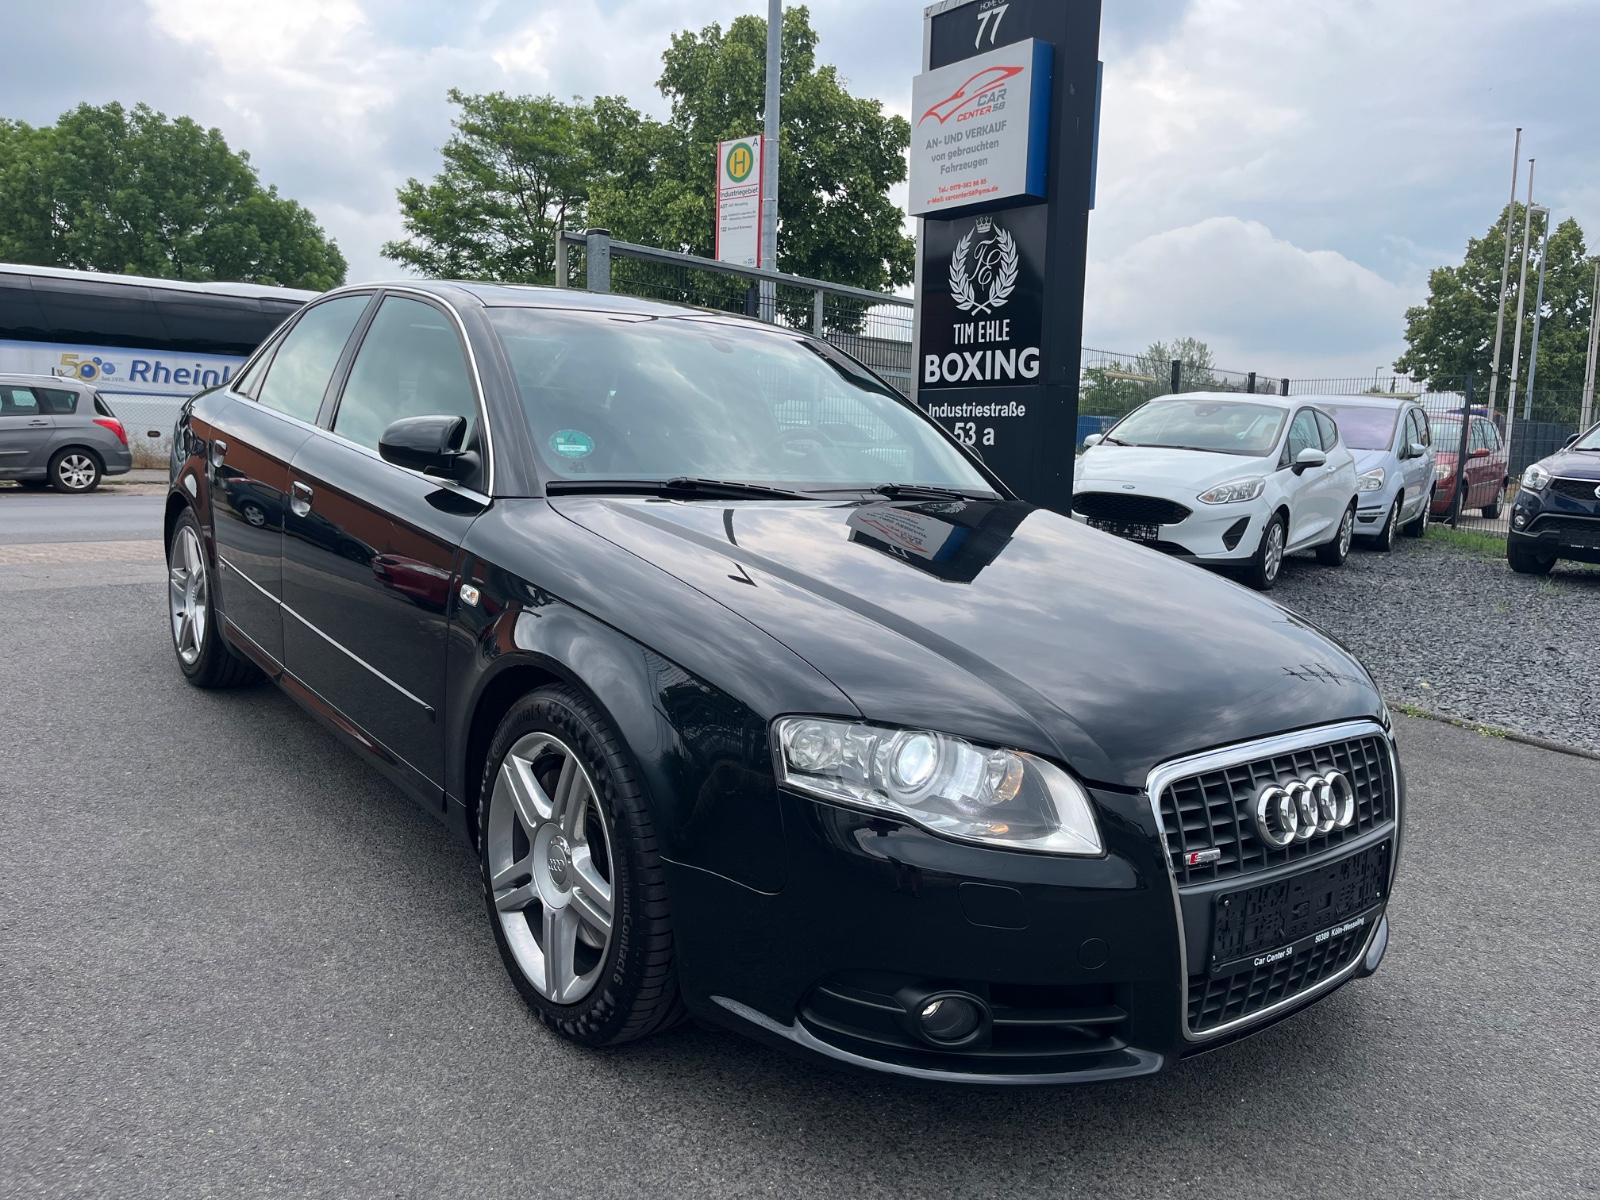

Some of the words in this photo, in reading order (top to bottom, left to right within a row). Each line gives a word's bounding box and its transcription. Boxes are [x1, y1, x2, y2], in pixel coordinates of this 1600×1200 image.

[975, 4, 1010, 50] 77
[977, 88, 1007, 106] CAR
[752, 138, 758, 146] A
[926, 138, 942, 150] AN-
[944, 132, 963, 146] UND
[965, 120, 1007, 140] VERKAUF
[931, 153, 946, 162] von
[948, 140, 1000, 161] gebrauchten
[940, 158, 988, 175] Fahrzeugen
[720, 187, 758, 199] Industriegebiet
[953, 322, 974, 345] TIM
[978, 319, 1010, 343] EHLE
[924, 346, 1040, 384] BOXING
[928, 401, 1026, 418] Industriestraße
[953, 422, 976, 446] 53
[982, 427, 995, 446] a
[1254, 956, 1266, 966] Car
[1266, 950, 1286, 964] Center
[1286, 947, 1293, 956] 58
